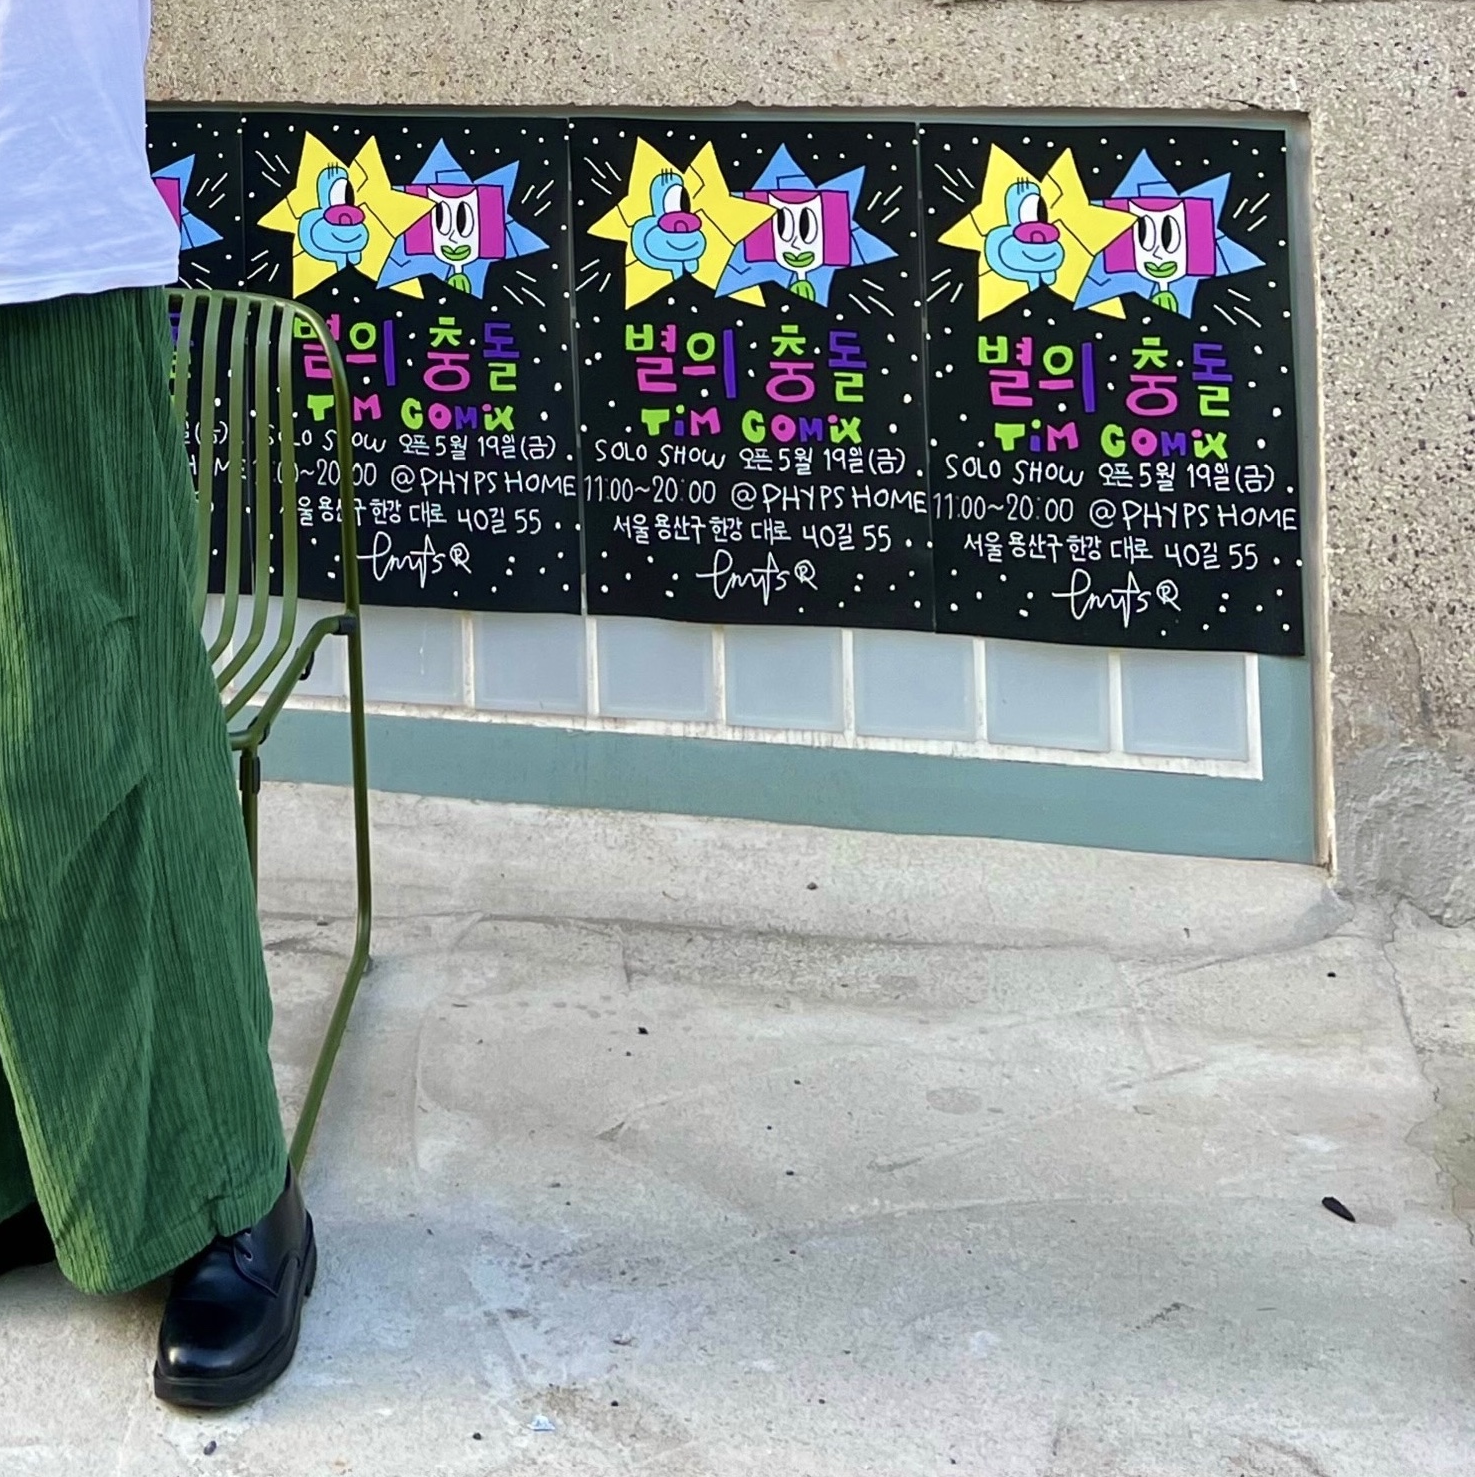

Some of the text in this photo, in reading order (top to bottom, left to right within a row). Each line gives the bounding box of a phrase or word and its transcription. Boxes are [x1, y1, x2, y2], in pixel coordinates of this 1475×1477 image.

[424, 317, 519, 391] 충돌
[624, 323, 866, 403] 별의 충돌
[978, 336, 1232, 418] 별의 충돌
[307, 393, 383, 423] TM
[321, 431, 387, 455] SOW
[399, 433, 430, 456] 오픈
[477, 433, 556, 462] 19일(금)
[594, 438, 648, 463] SOLO
[658, 444, 727, 470] SHOW
[740, 447, 773, 471] 오픈
[823, 447, 906, 477] 19일(금)
[504, 471, 577, 497] HOME
[946, 454, 1002, 480] SOLO
[1012, 460, 1084, 486] SHOW
[1098, 462, 1134, 488] 오픈
[1186, 462, 1274, 494] 19일(금)
[280, 496, 316, 525] 울
[457, 507, 507, 533] 40길
[514, 508, 542, 535] 55
[851, 486, 927, 512] HOME
[1216, 504, 1298, 530] HOME
[612, 513, 650, 544] 서울
[654, 513, 707, 544] 용산구
[802, 523, 855, 550] 40길
[862, 524, 891, 551] 55
[964, 532, 1004, 562] 서울
[1008, 532, 1064, 564] 용산구
[1164, 542, 1220, 570] 40길
[1228, 542, 1258, 570] 55
